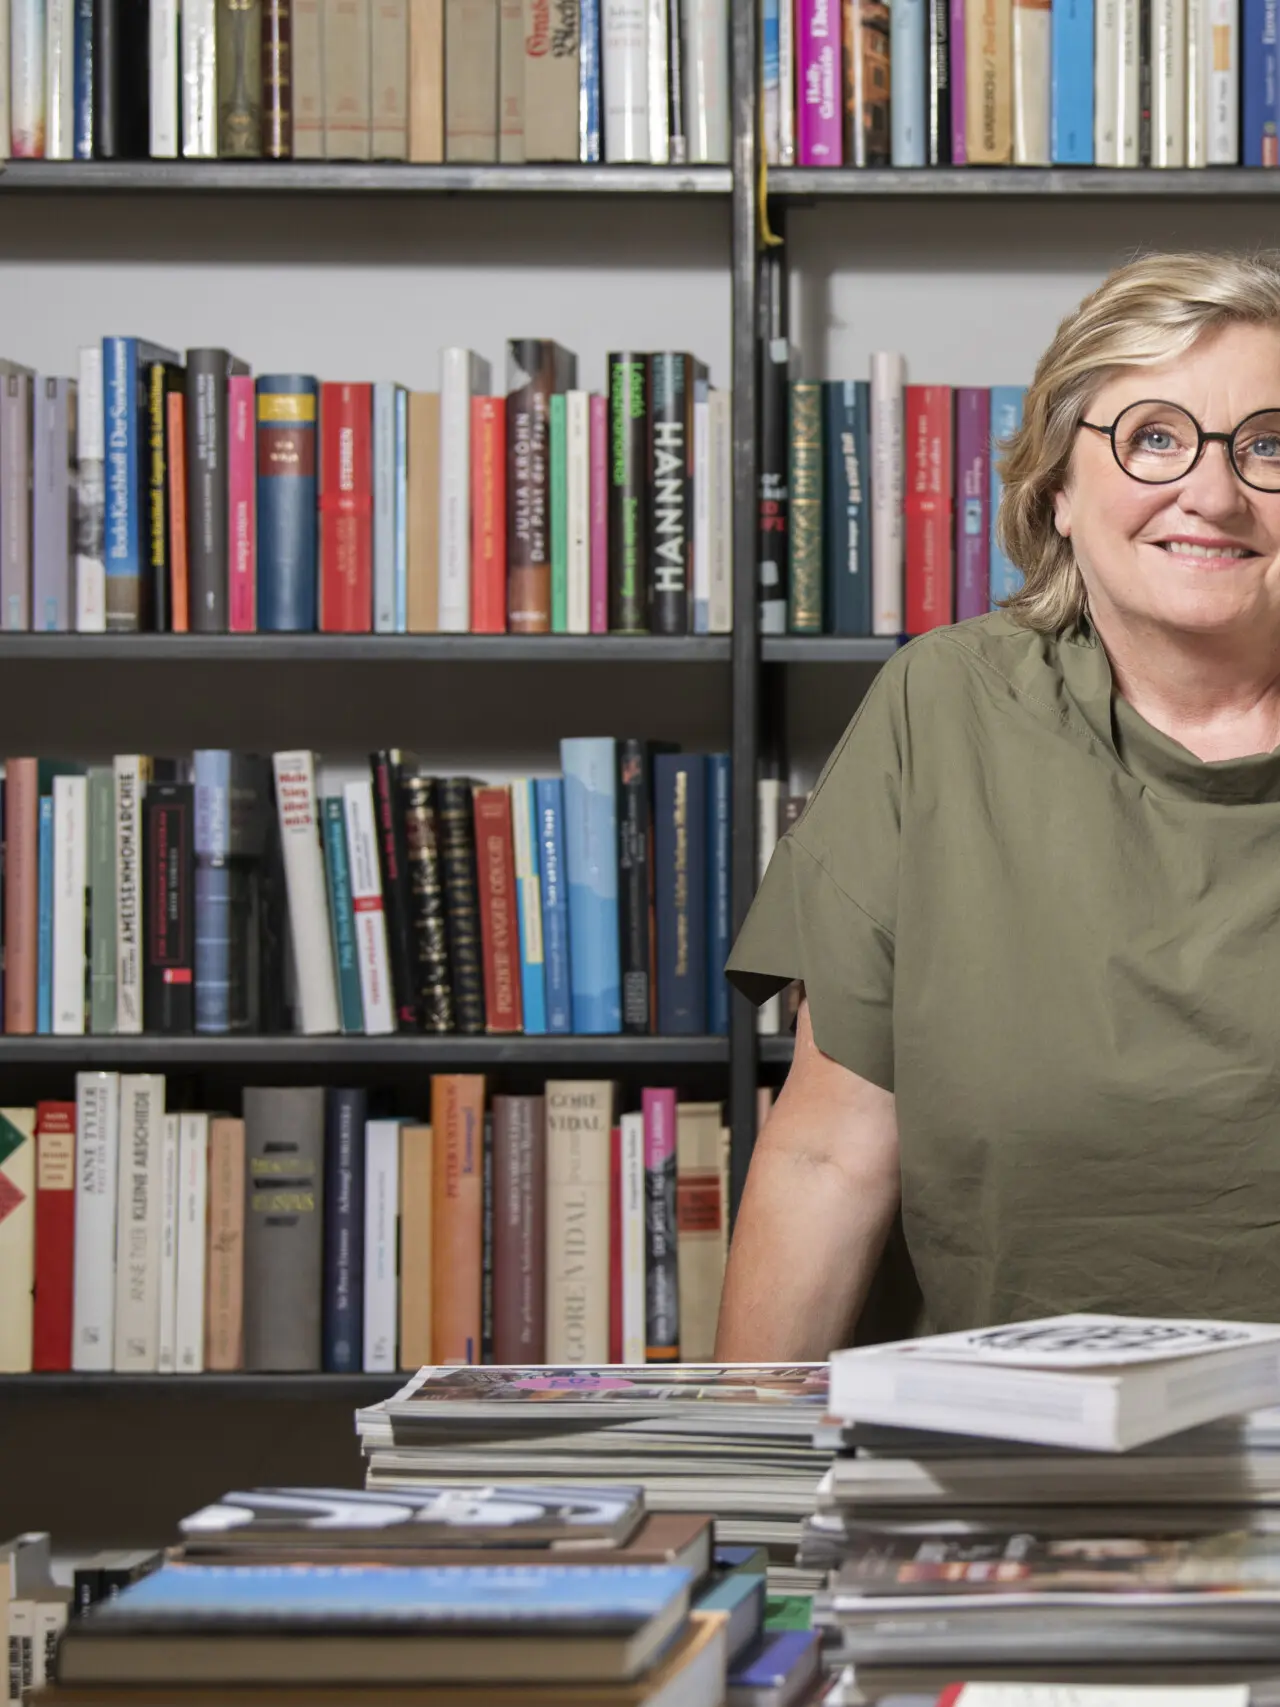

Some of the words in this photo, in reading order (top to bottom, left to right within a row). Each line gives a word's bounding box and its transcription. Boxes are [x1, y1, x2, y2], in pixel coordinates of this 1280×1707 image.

[529, 392, 544, 450] Frauen
[515, 486, 530, 541] JULIA
[654, 421, 685, 592] HANNAH
[530, 532, 545, 562] Der
[119, 771, 136, 944] AMEISENMONARCHIE
[84, 1086, 97, 1140] TYLER
[133, 1090, 150, 1169] ABSCHIEDE
[83, 1147, 96, 1194] ANNE
[133, 1173, 148, 1221] KLEINE
[445, 1152, 457, 1198] PETER
[563, 1192, 587, 1280] VIDAL
[563, 1287, 587, 1362] GORE
